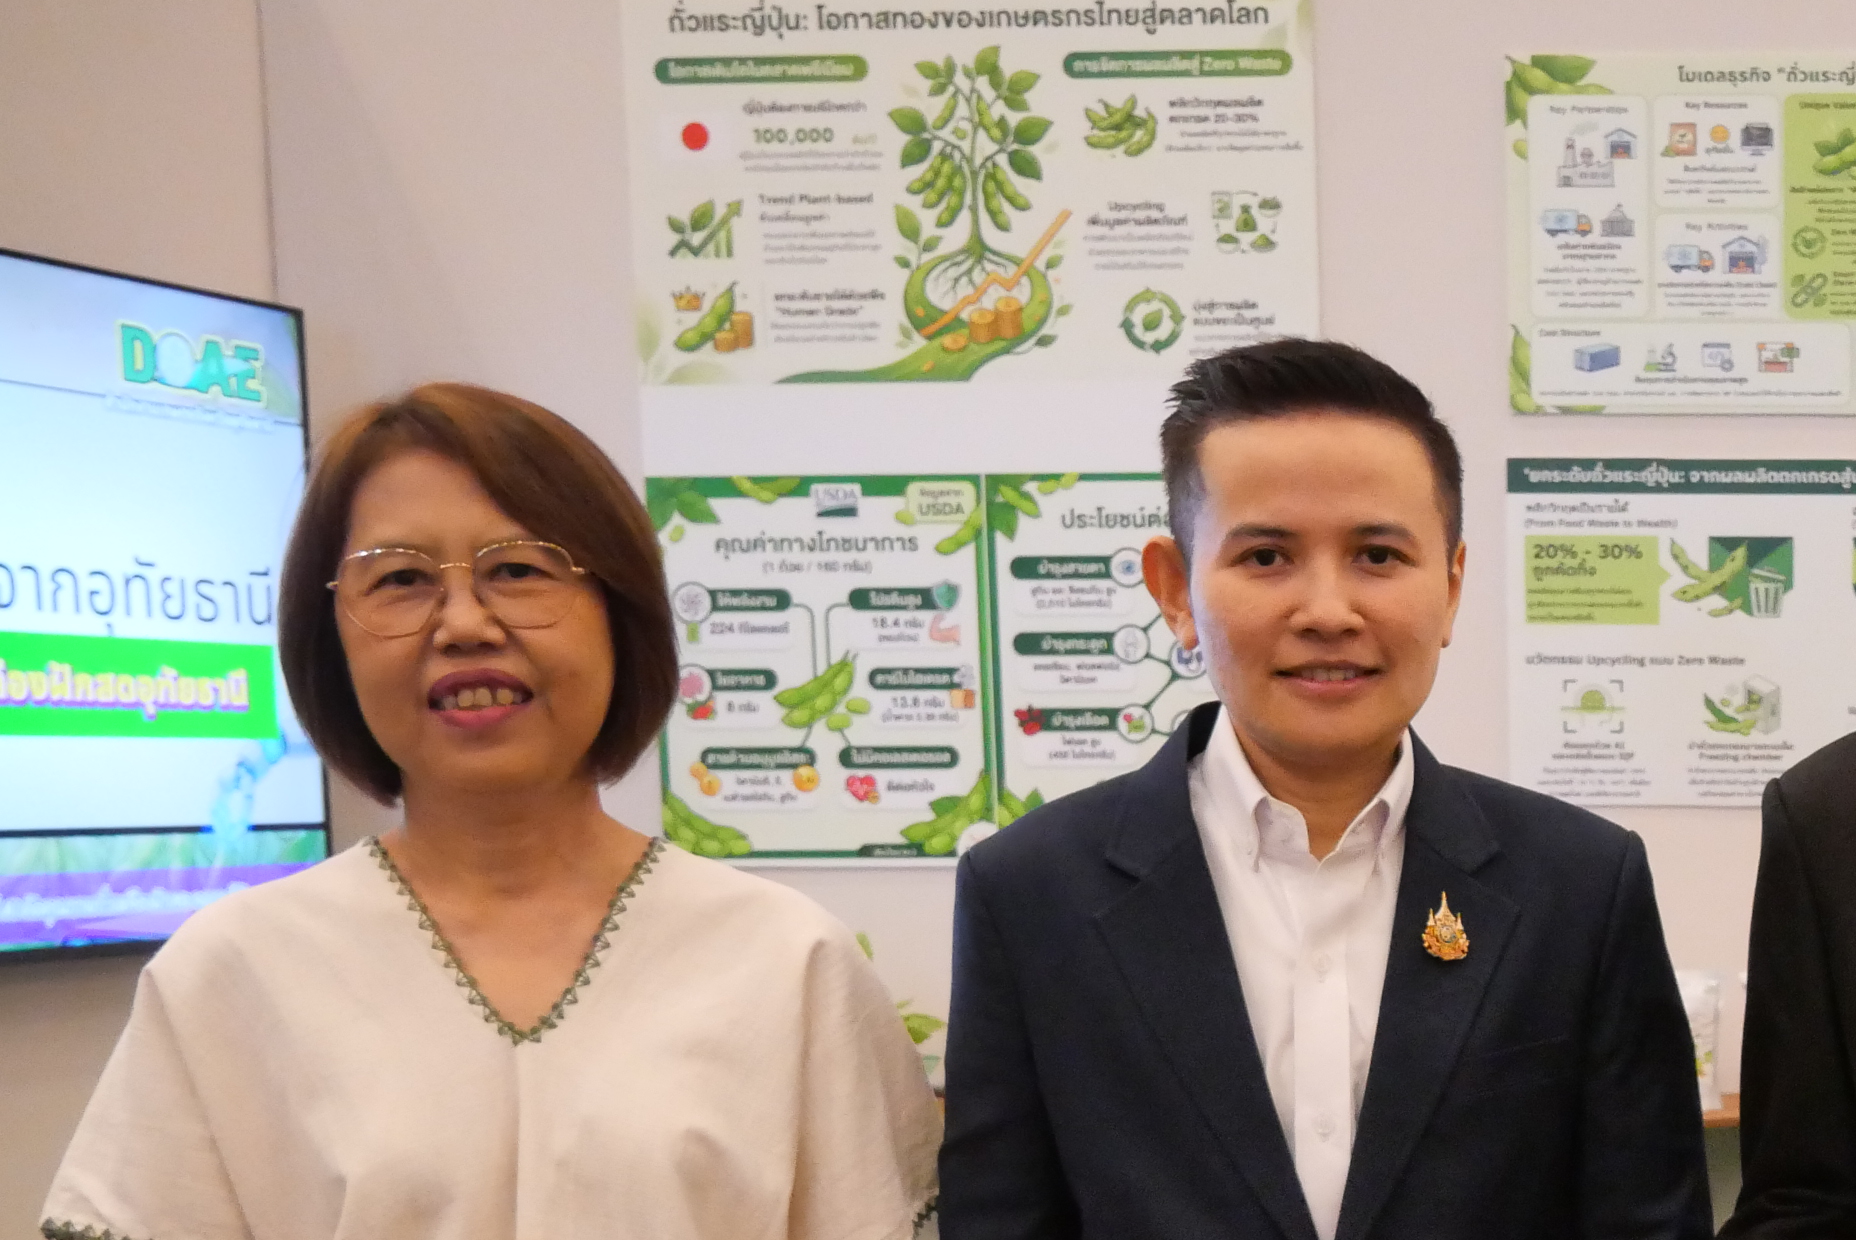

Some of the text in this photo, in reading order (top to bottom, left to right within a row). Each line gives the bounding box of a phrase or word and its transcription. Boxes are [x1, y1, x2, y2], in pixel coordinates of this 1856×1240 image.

[668, 0, 808, 39] ถั่วแระญี่ปุ่น:
[1678, 64, 1771, 87] โมเดลธุรกิจ
[753, 127, 834, 145] 100,000
[714, 530, 919, 560] คุณค่าทางโภชนาการ
[1533, 543, 1578, 560] 20%
[1598, 543, 1643, 560] 30%
